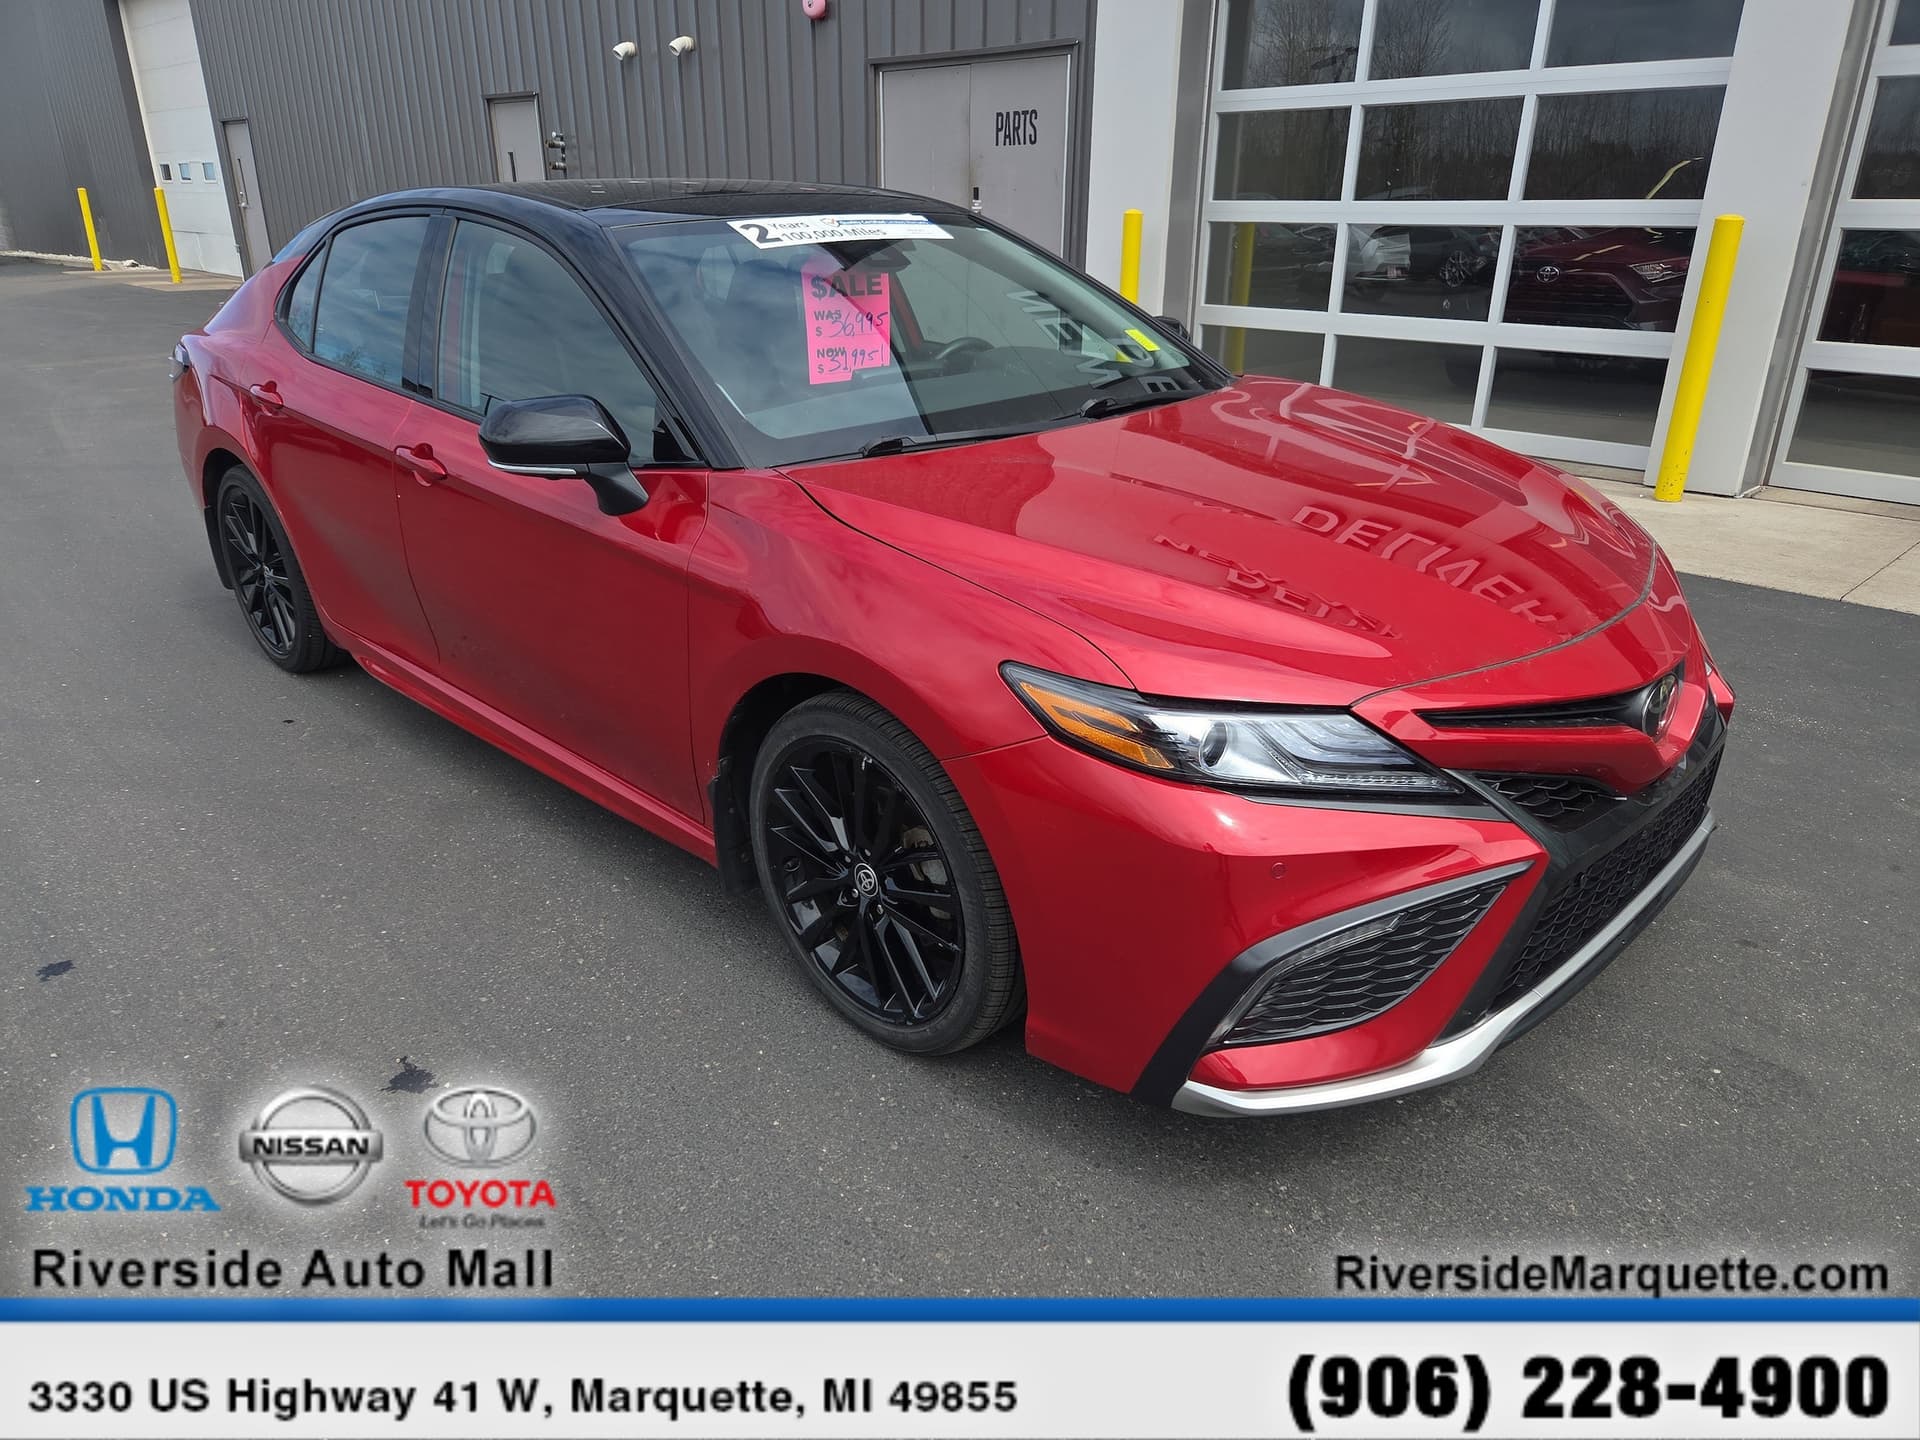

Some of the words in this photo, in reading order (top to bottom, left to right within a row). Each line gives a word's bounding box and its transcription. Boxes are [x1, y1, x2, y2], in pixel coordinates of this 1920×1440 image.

[995, 109, 1038, 147] PARTS
[740, 223, 783, 244] 2
[767, 219, 809, 231] Years
[782, 228, 844, 243] 100,000
[847, 225, 888, 238] Miles
[814, 309, 842, 321] WAS
[816, 346, 847, 359] NOW
